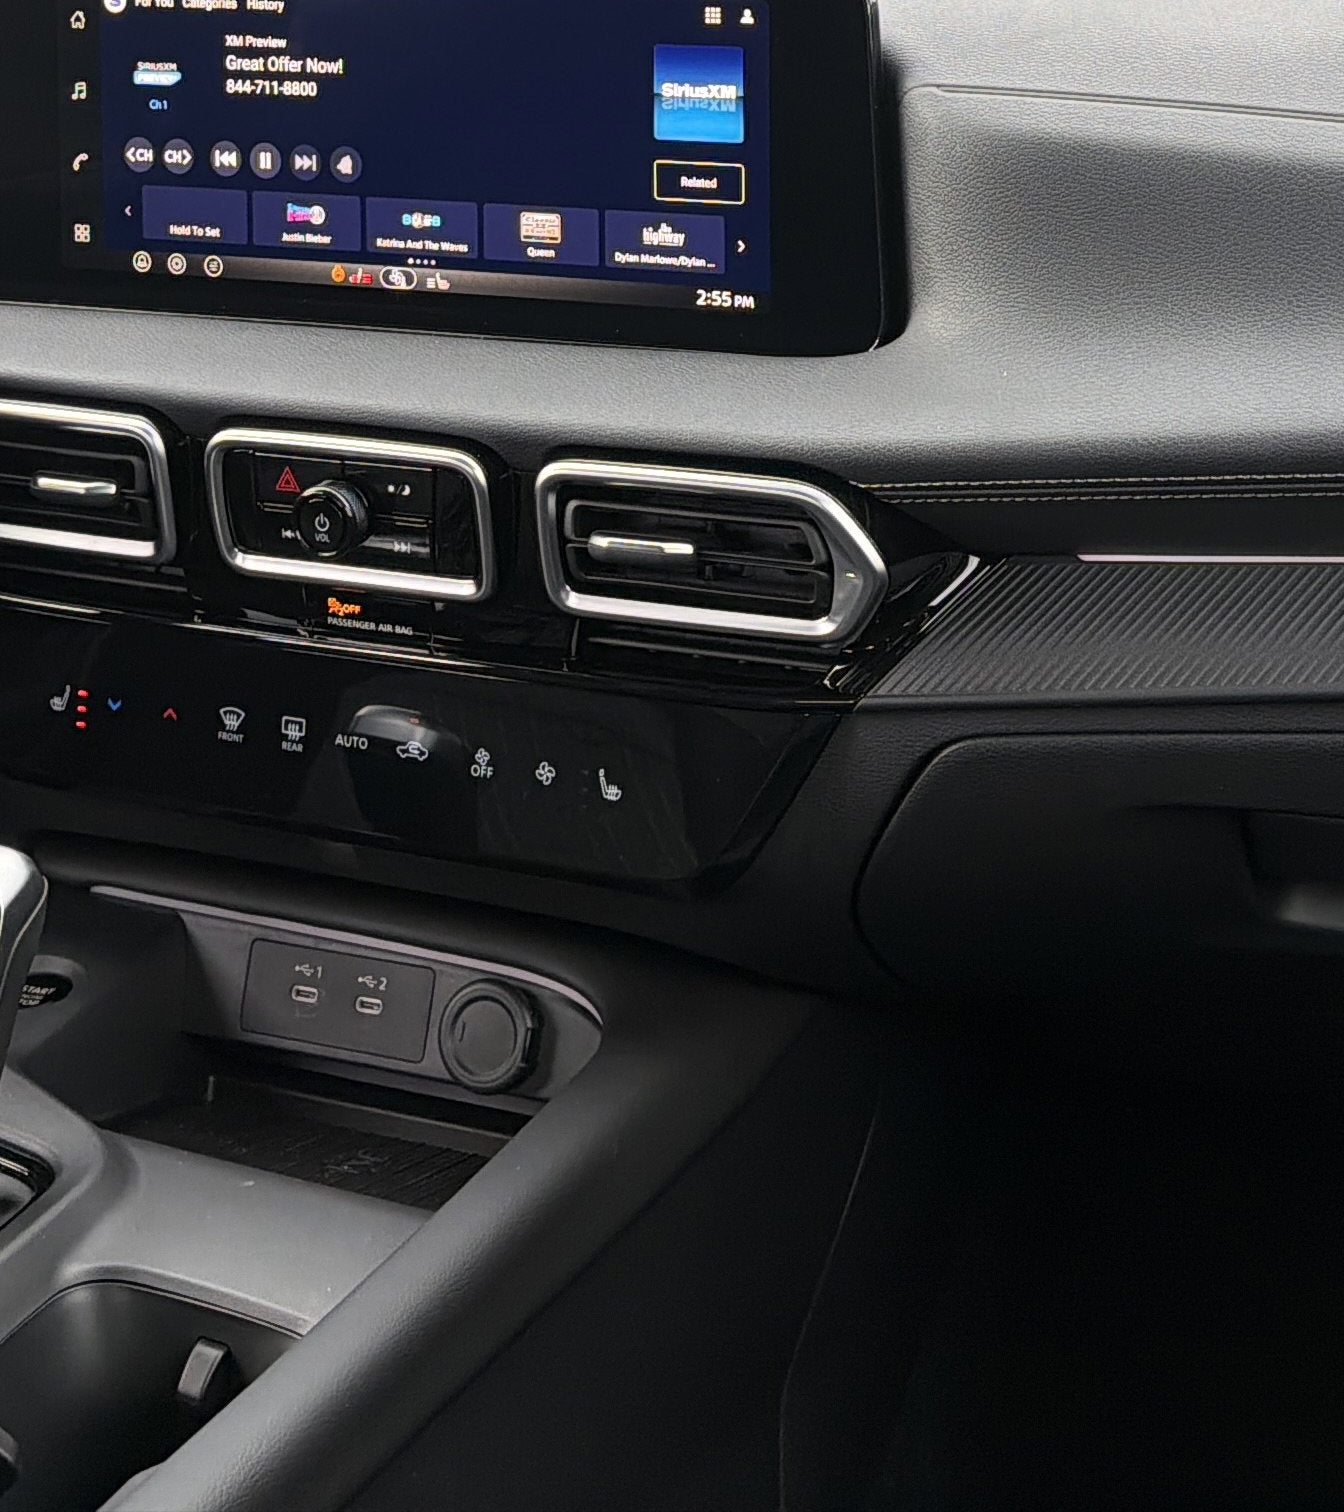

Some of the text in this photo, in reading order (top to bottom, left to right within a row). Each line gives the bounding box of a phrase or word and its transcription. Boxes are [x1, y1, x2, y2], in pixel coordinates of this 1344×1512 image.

[224, 34, 287, 48] XM Preview
[224, 54, 343, 74] Great Offer Now!
[225, 78, 317, 96] 844-711-8800
[660, 82, 736, 99] SiriusXM
[148, 98, 168, 110] Ch 1
[680, 175, 717, 189] Related
[168, 223, 220, 237] Hold To Set
[280, 231, 332, 244] Justin Bieber
[375, 237, 468, 252] Katrina And The Waves
[526, 245, 555, 258] Queen
[614, 250, 640, 263] Dylan
[695, 288, 755, 309] 2:55 PM
[314, 532, 330, 543] VOL
[342, 603, 360, 614] OFF
[326, 615, 413, 635] PASSENGER AIR BAG
[217, 730, 244, 743] FRONT
[334, 733, 368, 750] AUTO
[280, 740, 303, 752] REAR
[470, 763, 493, 778] OFF
[378, 976, 387, 990] 2
